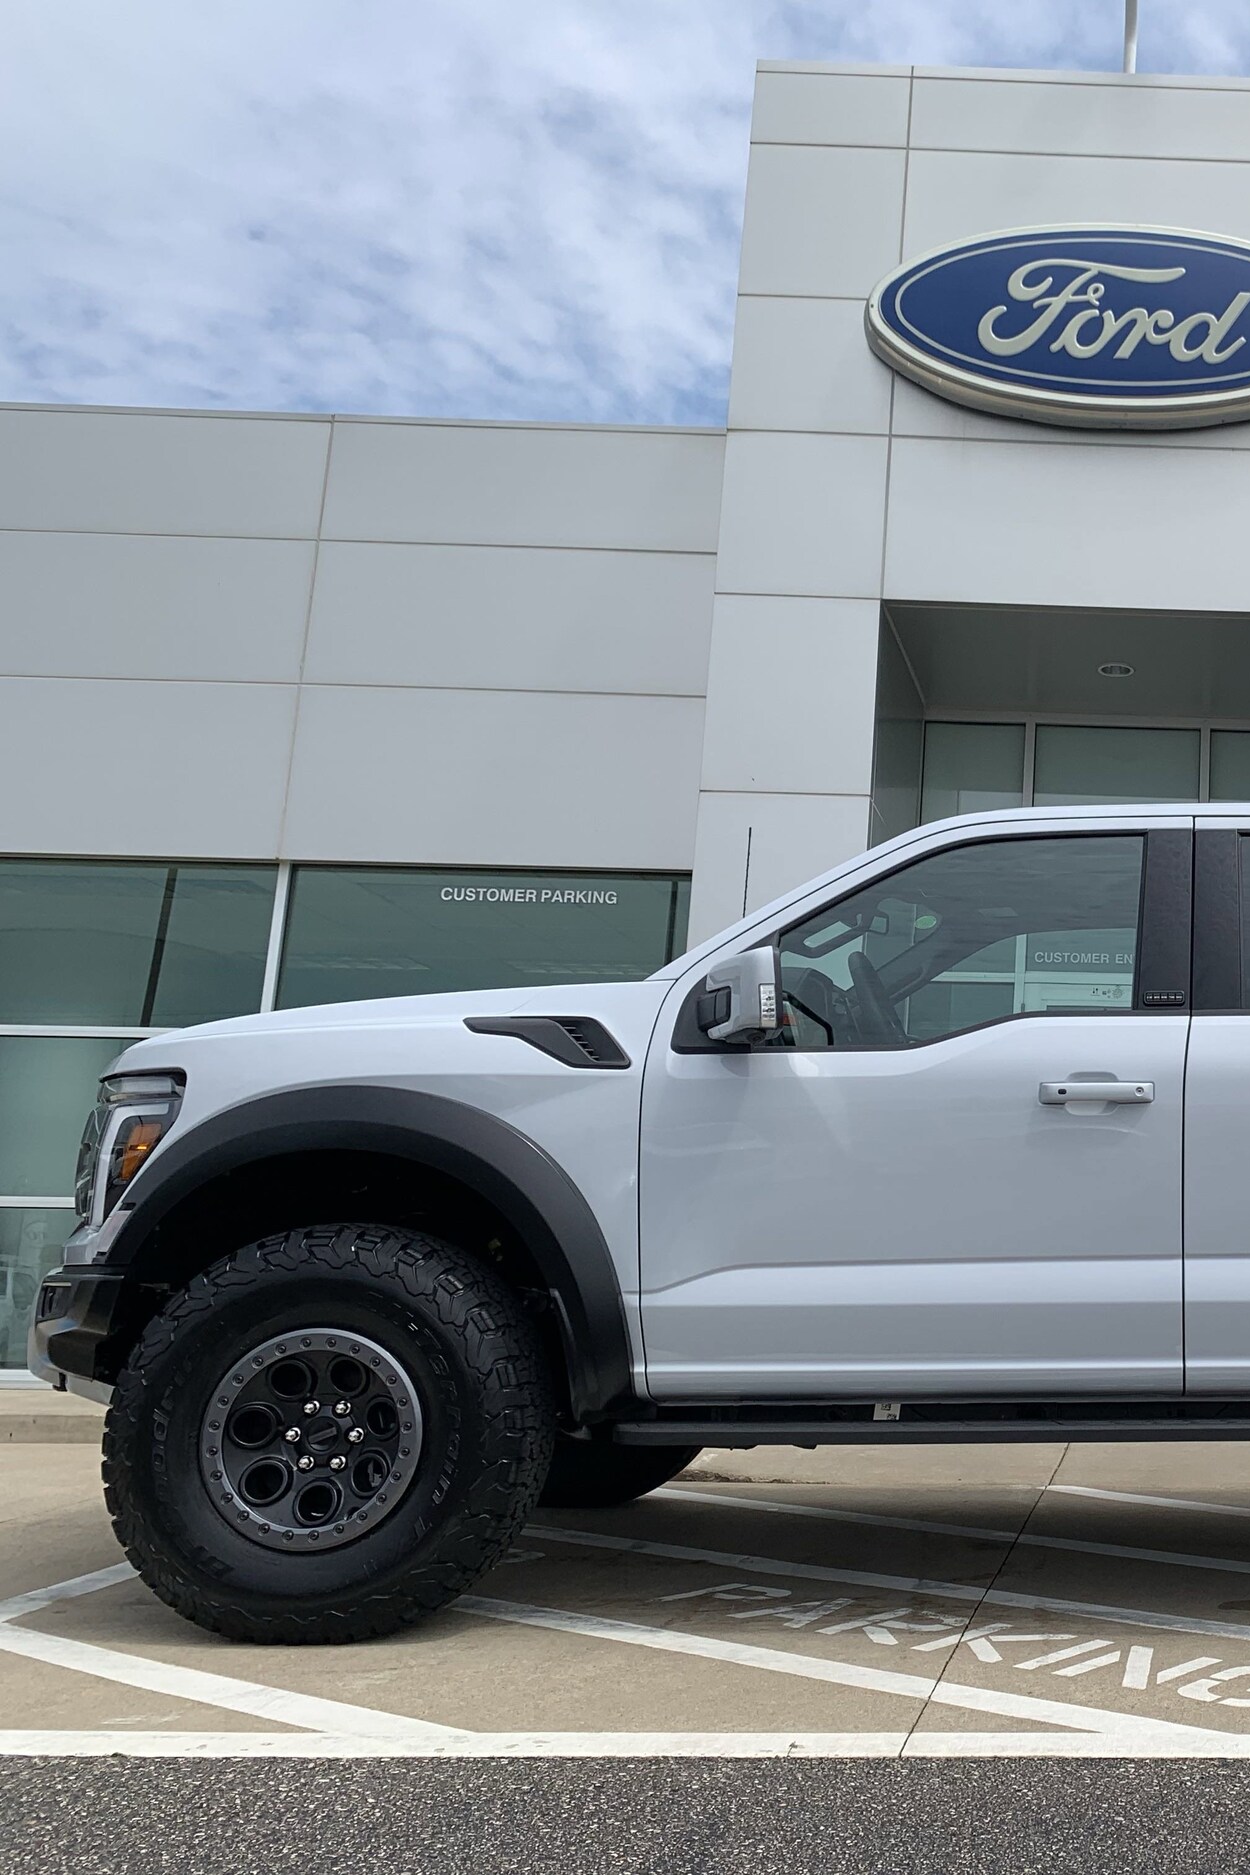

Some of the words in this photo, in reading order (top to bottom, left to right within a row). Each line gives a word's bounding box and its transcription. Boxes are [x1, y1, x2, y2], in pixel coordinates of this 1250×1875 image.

[440, 887, 537, 903] CUSTOMER
[540, 890, 618, 905] PARKING
[1034, 951, 1110, 964] CUSTOMER
[1115, 952, 1135, 964] EN
